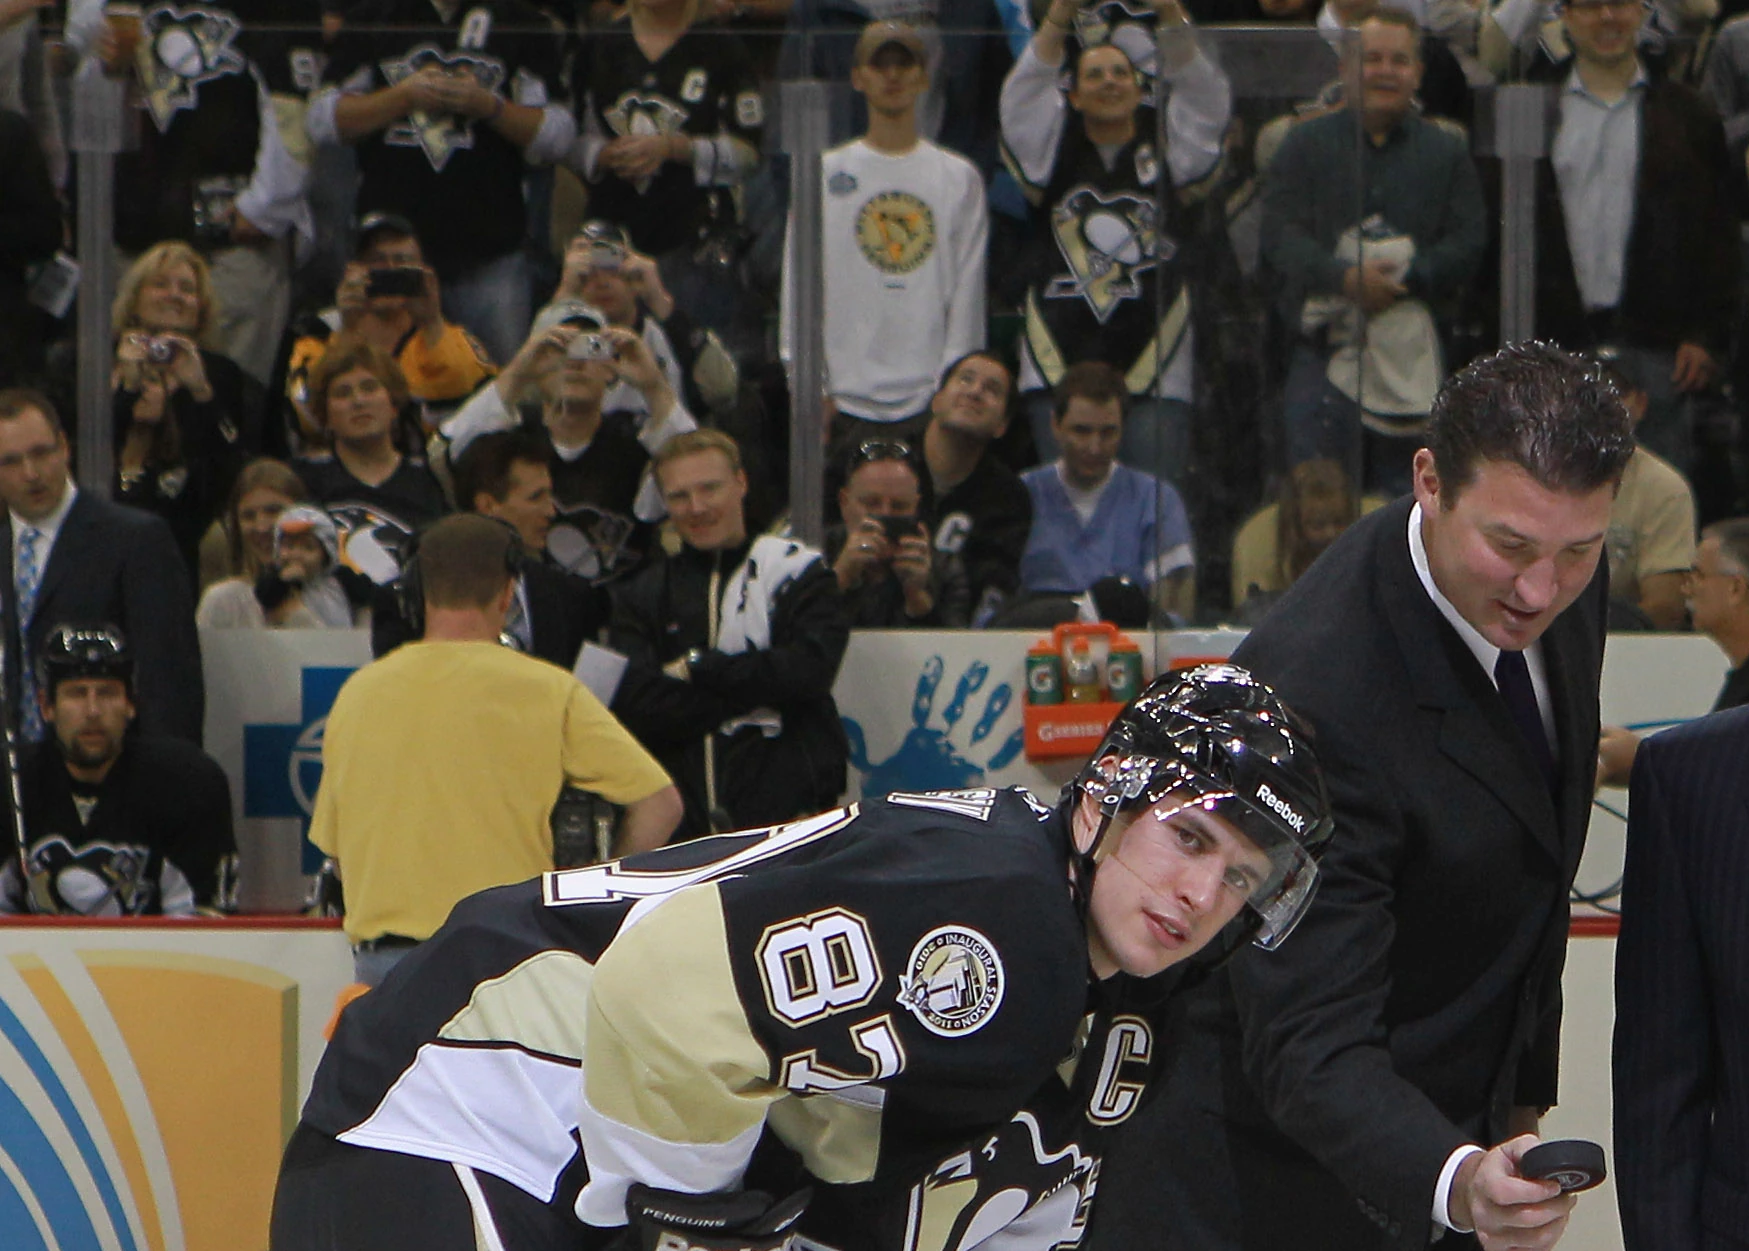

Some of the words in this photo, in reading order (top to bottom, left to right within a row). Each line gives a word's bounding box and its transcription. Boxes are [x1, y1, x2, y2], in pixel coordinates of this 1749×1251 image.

[1029, 662, 1054, 693] G
[1255, 783, 1307, 834] Reebok
[945, 934, 997, 983] INAUGURAL
[754, 905, 907, 1096] 87
[961, 985, 998, 1028] SEASON
[1086, 1014, 1153, 1126] C
[642, 1206, 727, 1228] PENGUINS
